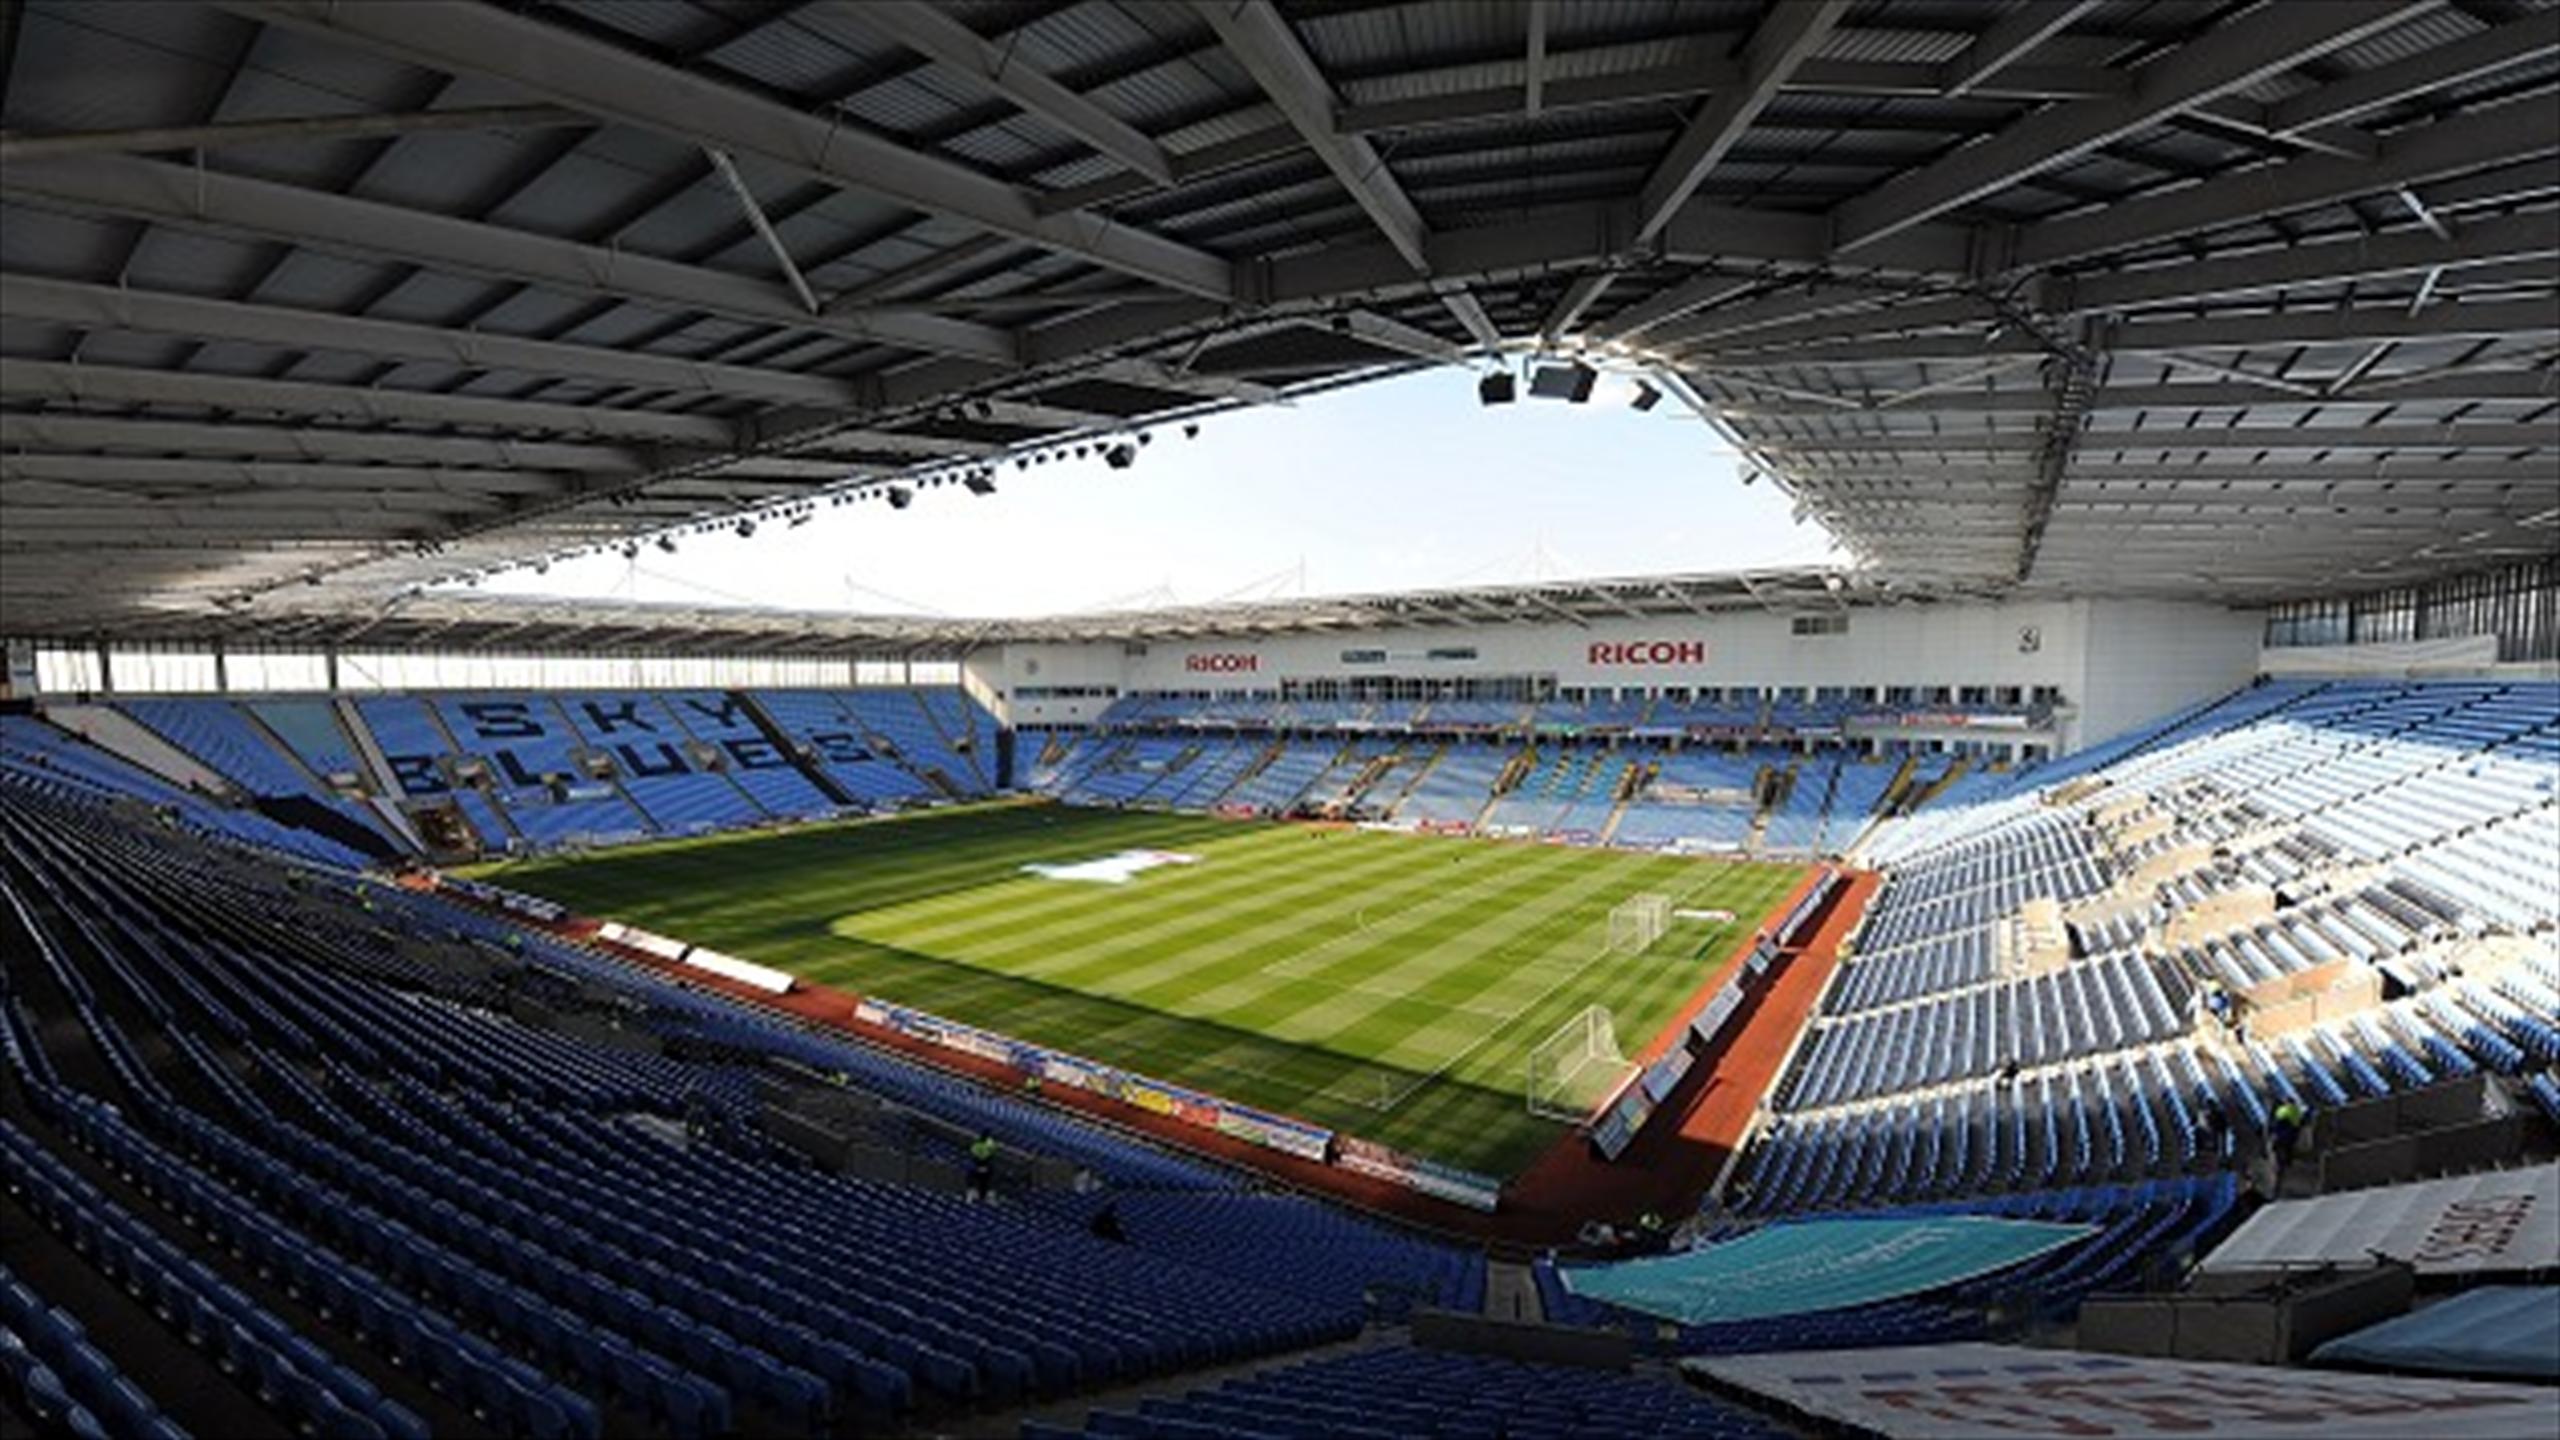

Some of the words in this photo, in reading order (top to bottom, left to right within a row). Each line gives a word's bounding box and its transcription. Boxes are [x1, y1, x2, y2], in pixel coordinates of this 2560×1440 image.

[1185, 653, 1257, 672] RICOH
[1589, 642, 1704, 664] RICOH
[459, 696, 742, 738] SKY
[386, 735, 875, 793] BLUES
